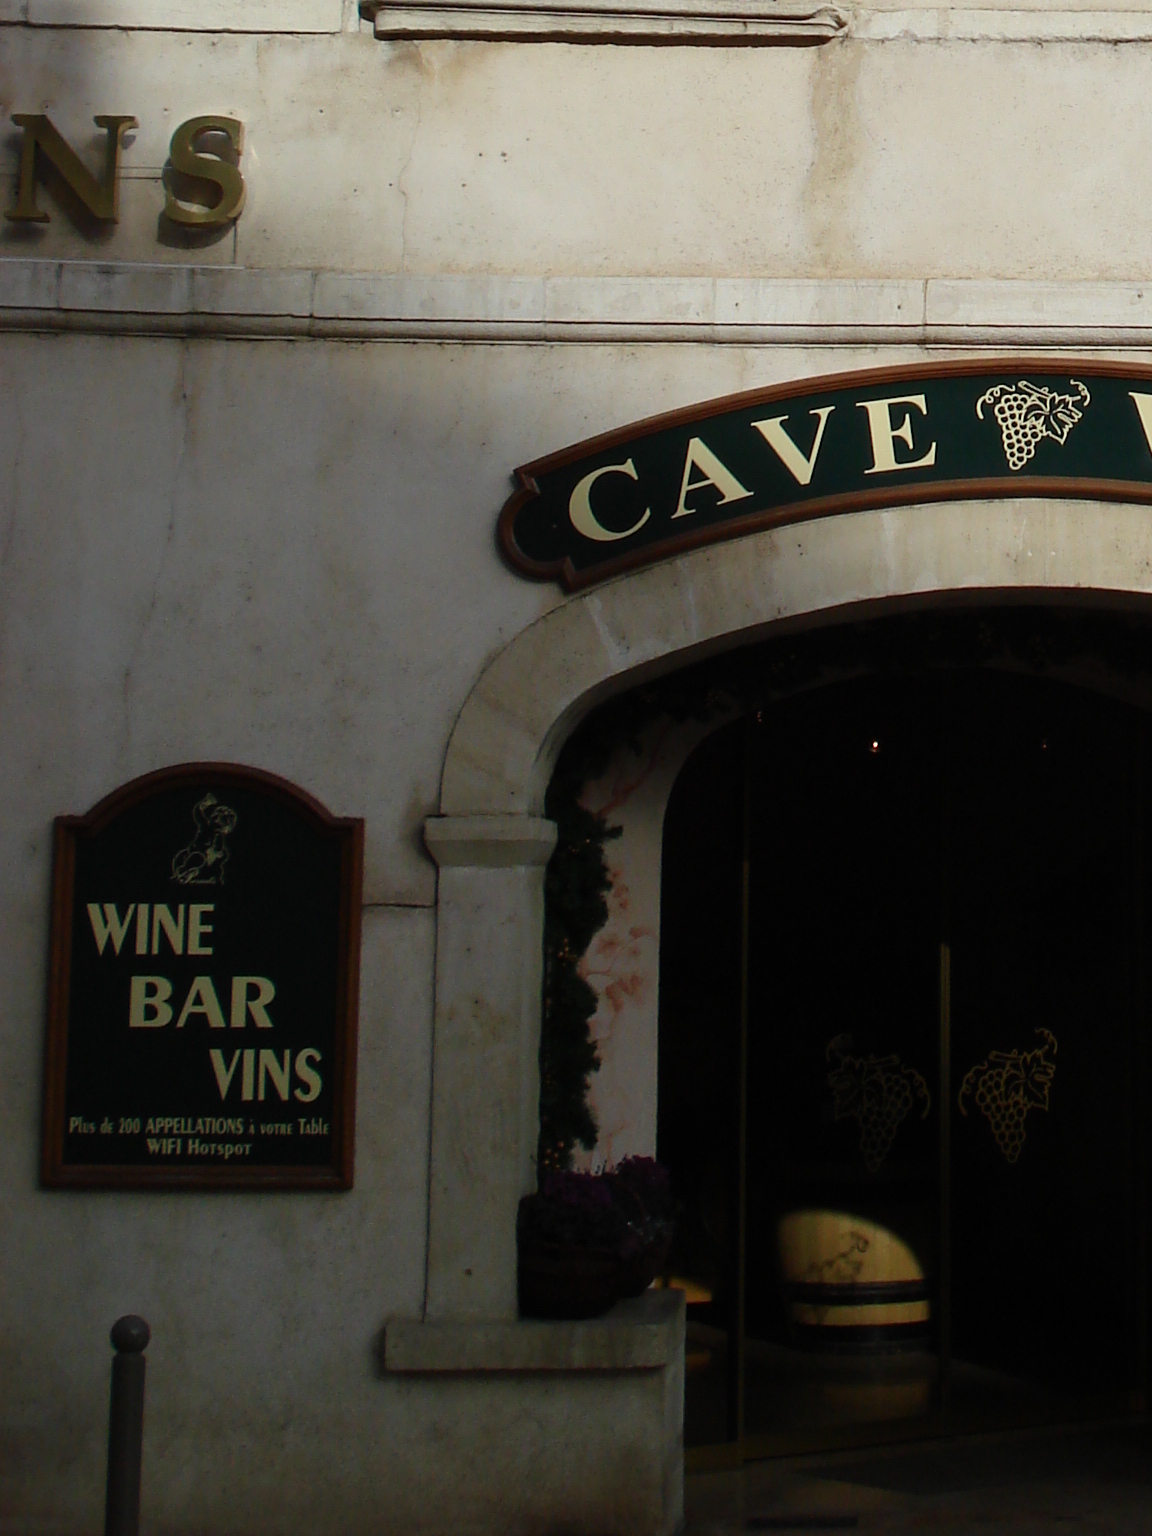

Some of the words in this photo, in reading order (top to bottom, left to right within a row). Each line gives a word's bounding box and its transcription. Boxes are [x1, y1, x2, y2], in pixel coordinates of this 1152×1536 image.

[569, 393, 937, 541] CAVE
[86, 903, 215, 956] WINE
[128, 975, 276, 1028] BAR
[208, 1047, 323, 1103] VINS
[69, 1116, 97, 1134] Plus
[118, 1117, 141, 1134] 200
[145, 1117, 244, 1135] APPELLATIONS
[298, 1117, 330, 1135] Table
[146, 1137, 182, 1155] WIFI
[187, 1138, 252, 1160] Hotspot
